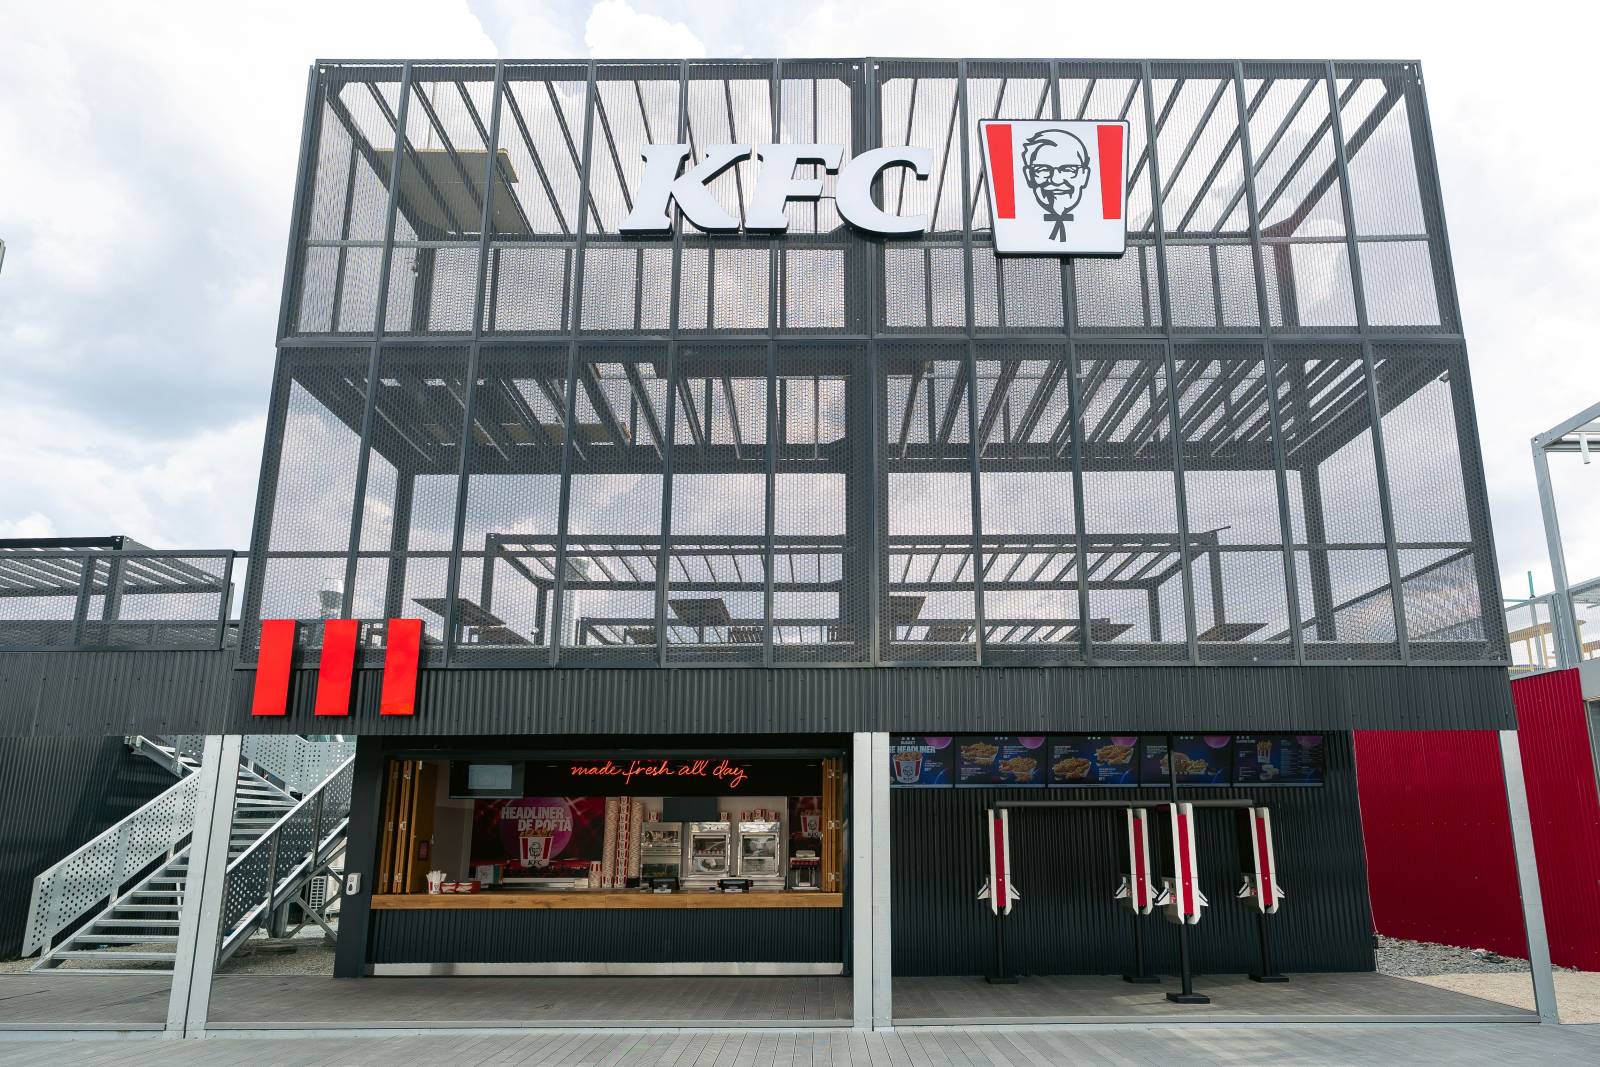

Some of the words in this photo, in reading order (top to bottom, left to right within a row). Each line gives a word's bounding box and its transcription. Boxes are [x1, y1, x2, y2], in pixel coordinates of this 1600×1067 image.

[619, 144, 932, 234] KFC
[571, 760, 622, 776] made
[622, 760, 673, 785] fresh
[678, 760, 707, 776] all
[713, 760, 748, 788] day
[501, 806, 564, 819] HEADLINER
[518, 819, 533, 832] DE
